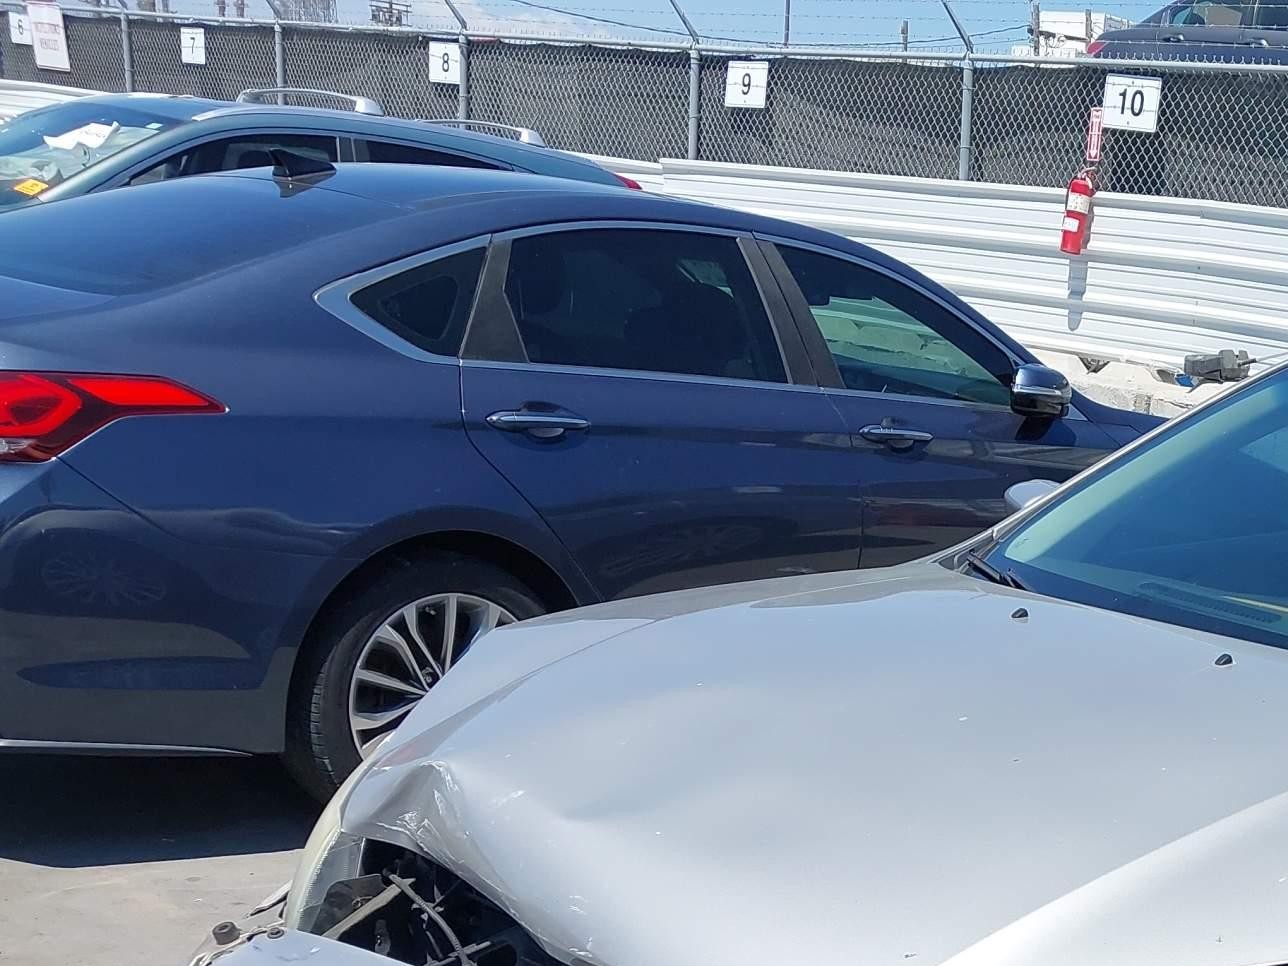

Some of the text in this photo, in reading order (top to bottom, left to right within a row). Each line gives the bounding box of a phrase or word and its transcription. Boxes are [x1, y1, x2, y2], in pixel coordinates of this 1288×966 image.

[190, 36, 195, 54] 7
[442, 52, 450, 73] 8
[742, 72, 752, 96] 9
[1118, 88, 1145, 117] 10
